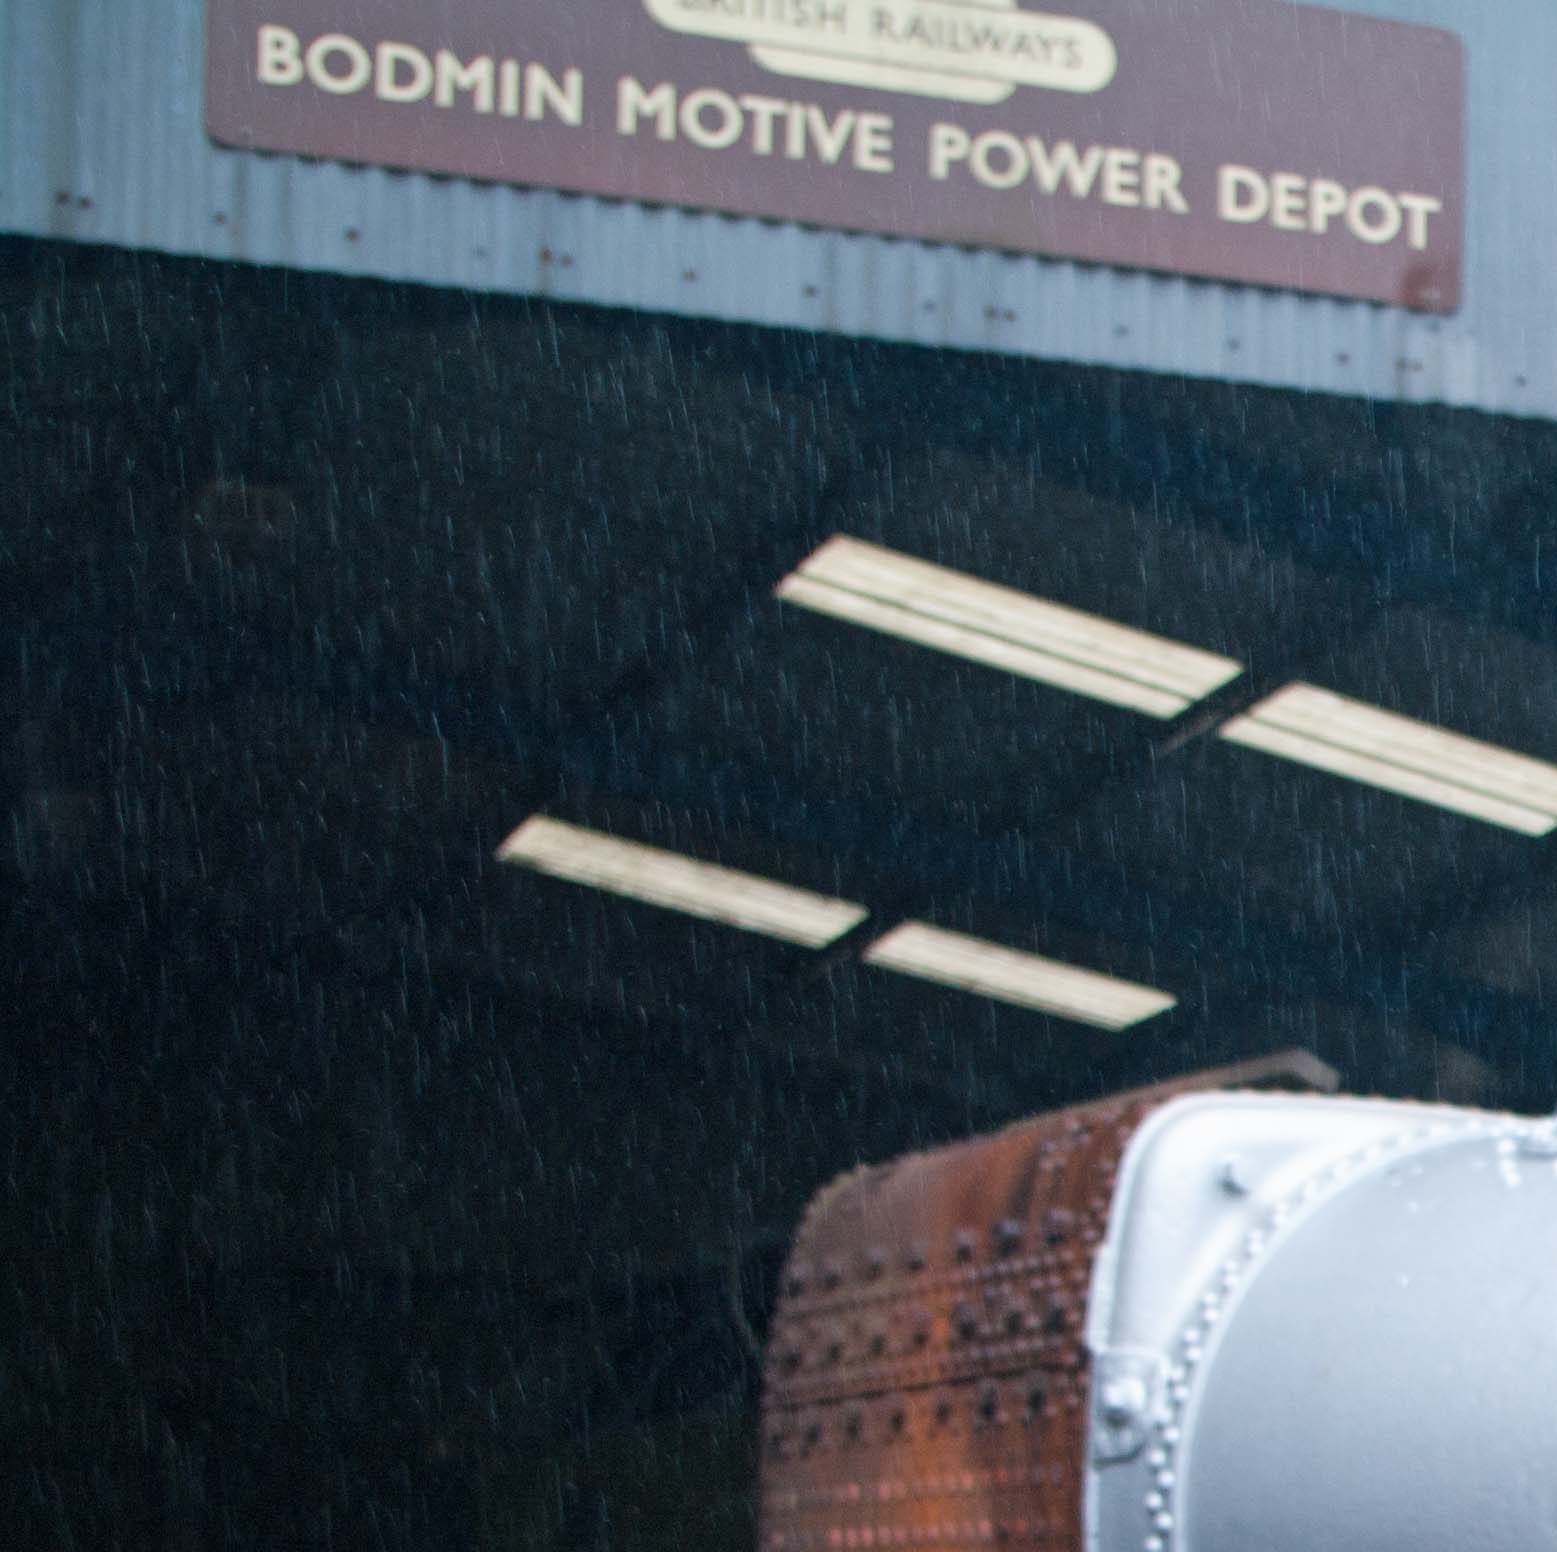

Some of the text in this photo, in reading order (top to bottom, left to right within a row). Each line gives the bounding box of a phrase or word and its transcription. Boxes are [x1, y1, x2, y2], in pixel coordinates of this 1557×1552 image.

[870, 6, 1084, 71] RAILWAYS
[256, 24, 1441, 251] BODMIN MOTIVE POWER DEPOT
